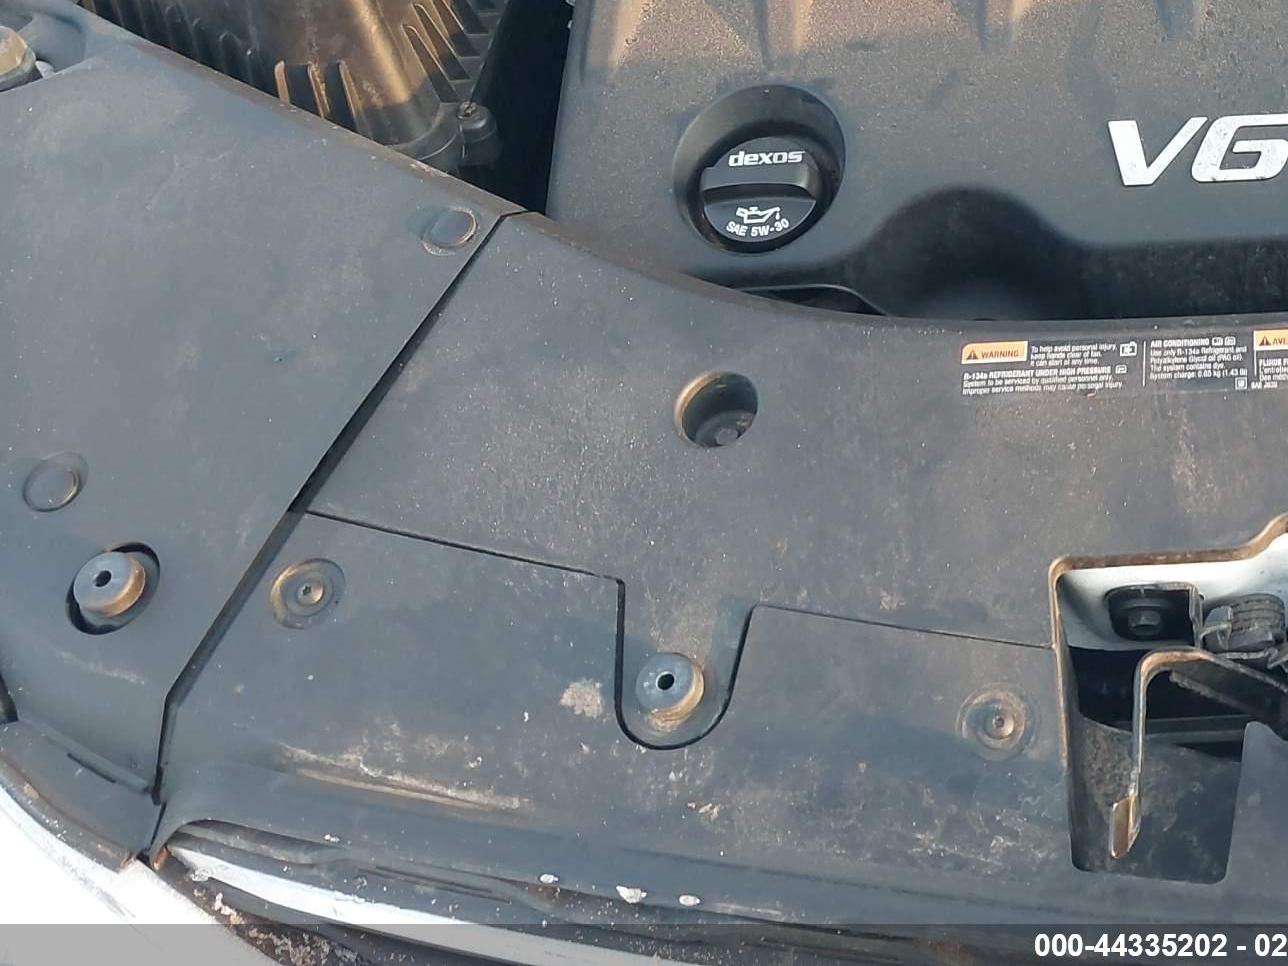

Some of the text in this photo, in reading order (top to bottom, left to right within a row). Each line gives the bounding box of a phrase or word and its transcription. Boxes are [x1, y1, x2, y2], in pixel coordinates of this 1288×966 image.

[728, 151, 806, 167] dexos
[726, 218, 790, 237] SAE 5W-30
[1163, 339, 1209, 347] CONDITIONING
[1072, 344, 1098, 352] personal
[982, 350, 1019, 358] WARNING
[1077, 366, 1111, 374] PRESSURE
